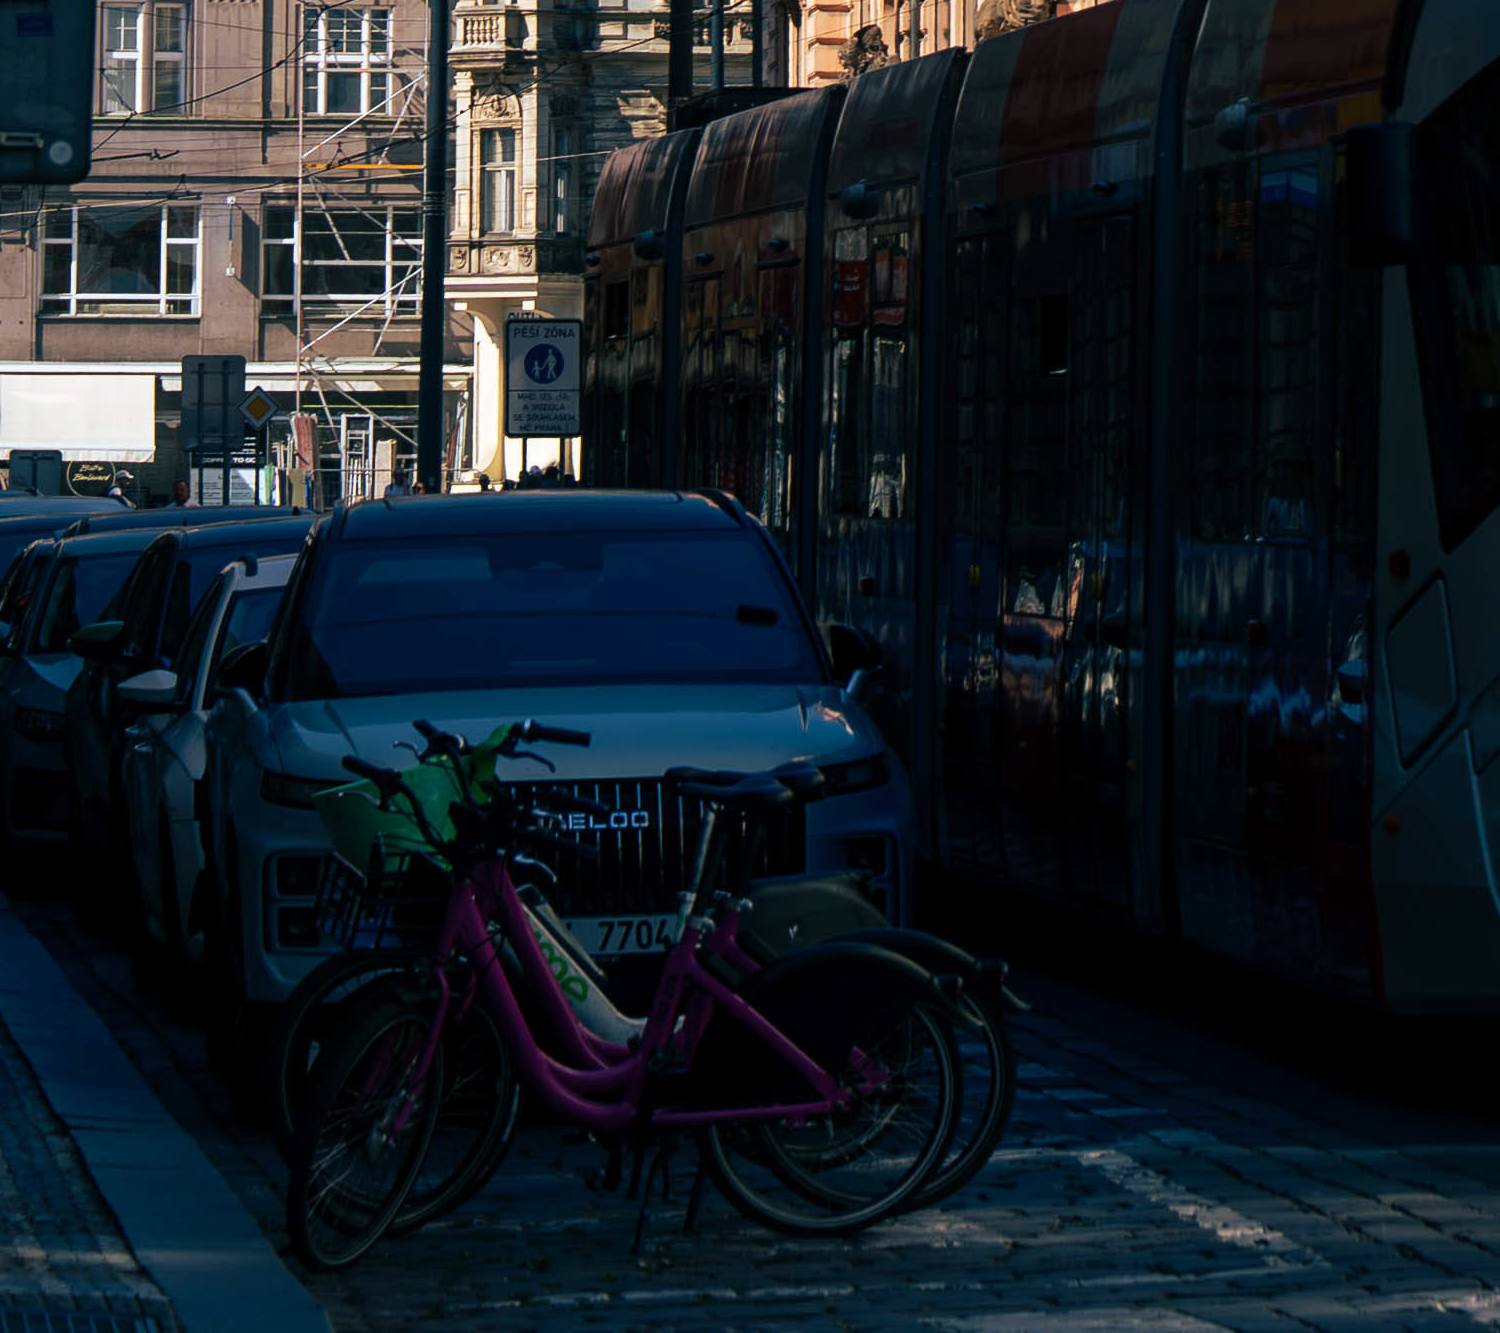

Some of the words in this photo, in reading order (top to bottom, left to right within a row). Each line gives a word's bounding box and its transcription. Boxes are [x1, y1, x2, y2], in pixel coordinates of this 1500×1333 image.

[513, 325, 540, 339] PĚŠÍ
[544, 326, 576, 339] ZÓNA
[598, 919, 670, 951] 7704
